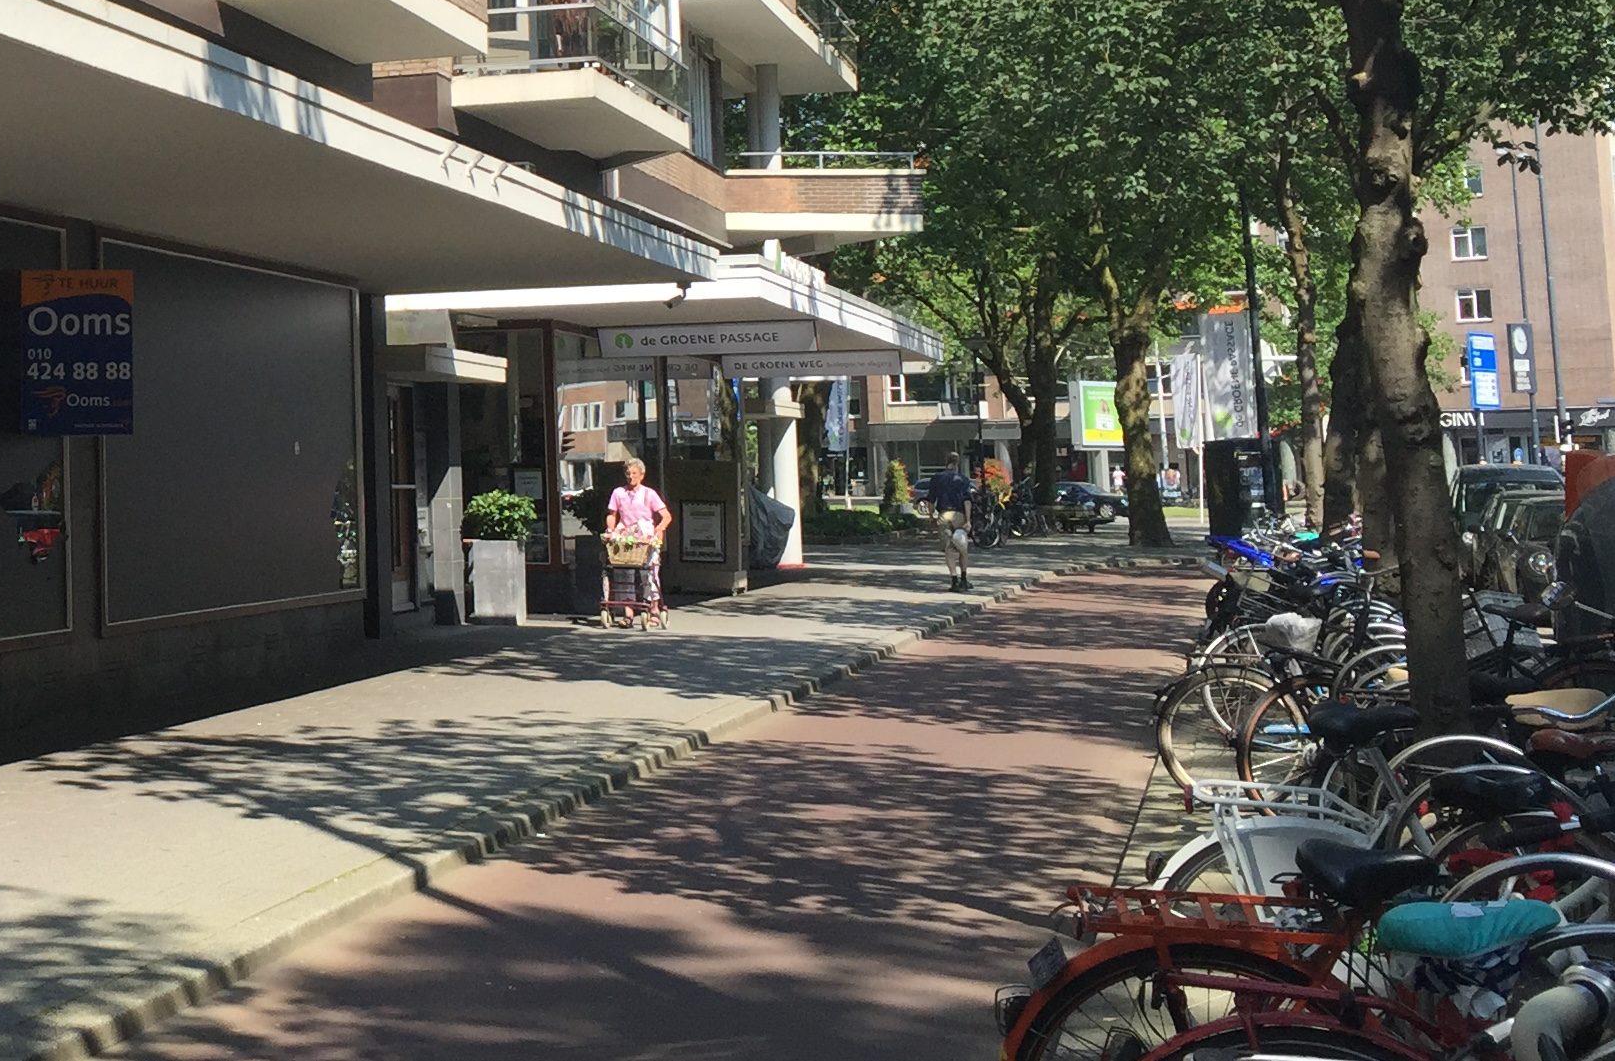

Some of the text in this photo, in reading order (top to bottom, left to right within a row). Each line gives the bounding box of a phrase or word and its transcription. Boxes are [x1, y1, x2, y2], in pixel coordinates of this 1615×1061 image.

[79, 277, 118, 290] HUUR
[27, 306, 130, 336] Ooms
[640, 331, 779, 347] de GROENE PASSAGE
[27, 348, 52, 360] 010
[27, 362, 131, 380] 424 88 88
[734, 362, 748, 370] DE
[751, 361, 795, 370] GROENE
[798, 360, 823, 369] WEG
[66, 393, 110, 407] Ooms
